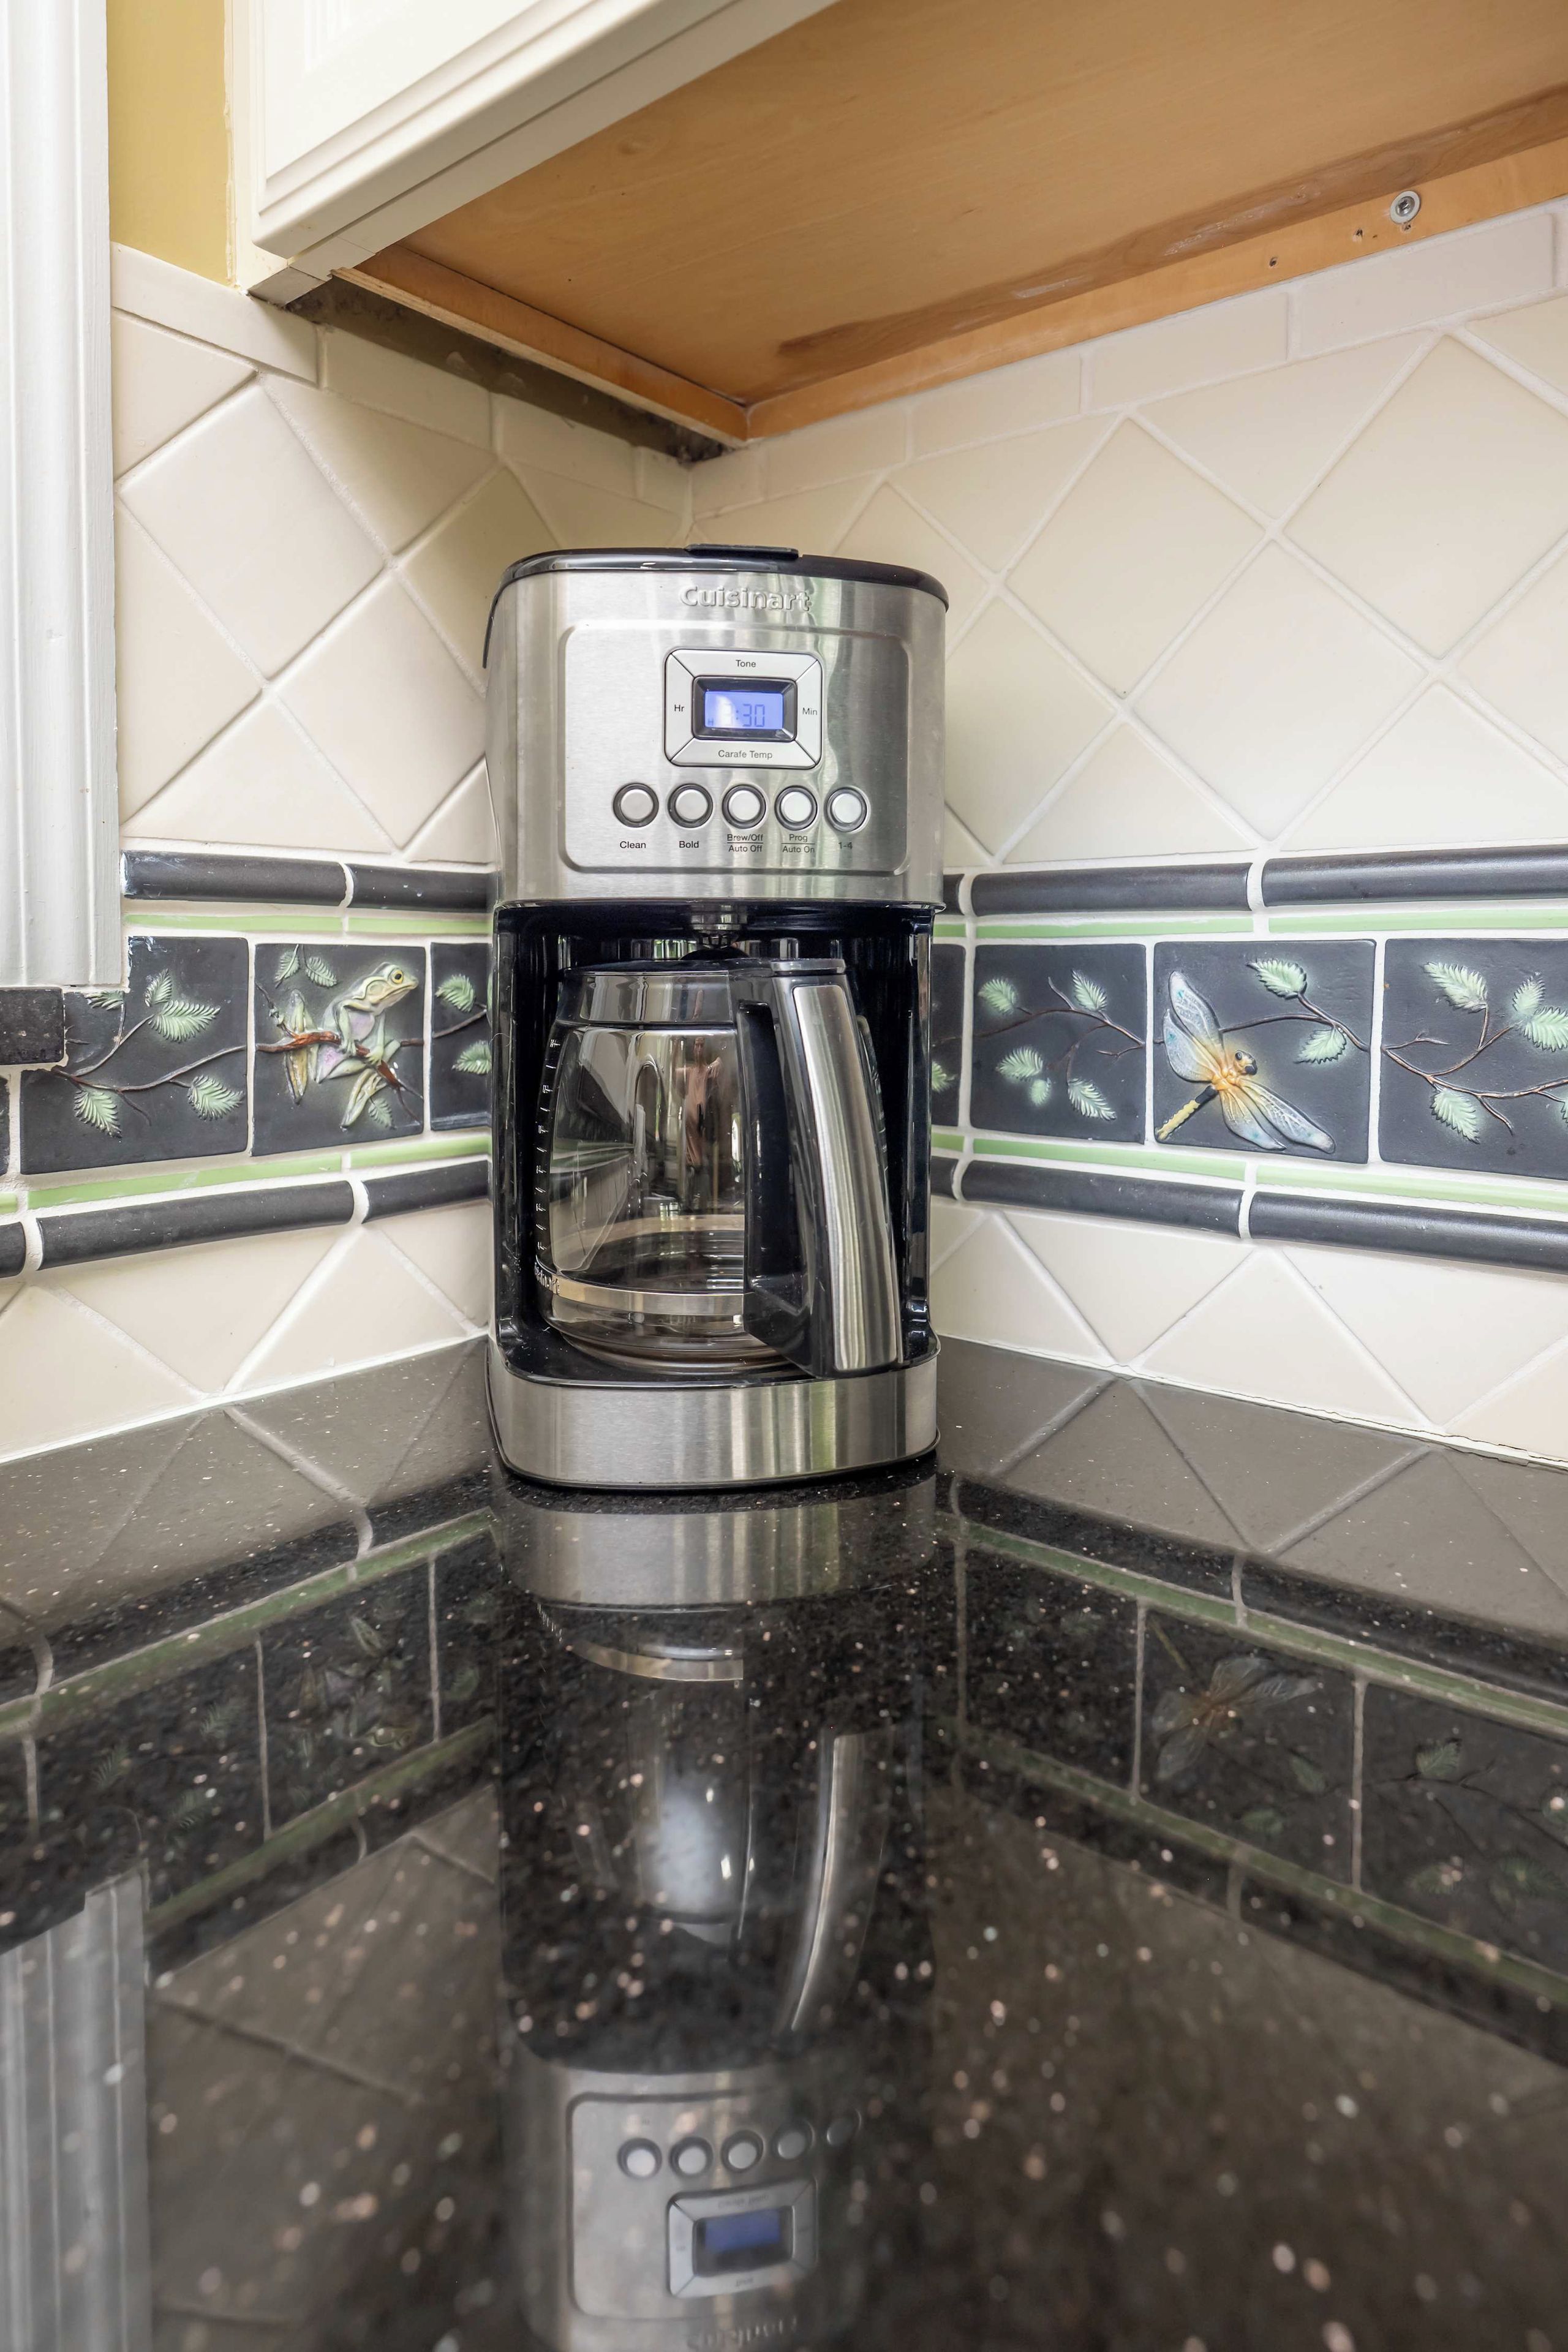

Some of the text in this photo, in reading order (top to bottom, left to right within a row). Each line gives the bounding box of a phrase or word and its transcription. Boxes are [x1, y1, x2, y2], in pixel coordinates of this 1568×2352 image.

[680, 586, 810, 611] Cuisinart
[718, 749, 773, 760] Carafe Temp
[789, 834, 808, 843] Prog
